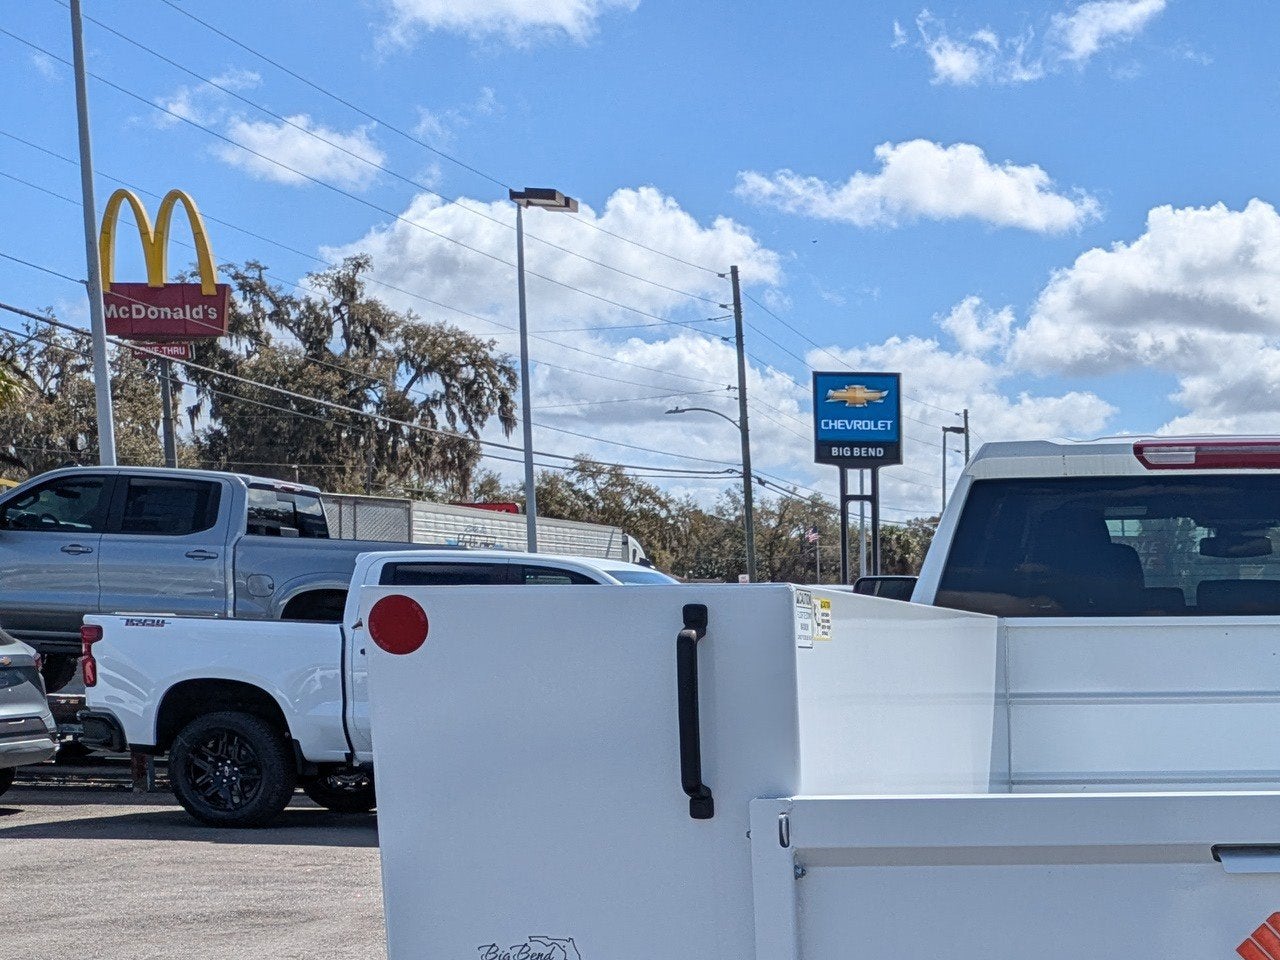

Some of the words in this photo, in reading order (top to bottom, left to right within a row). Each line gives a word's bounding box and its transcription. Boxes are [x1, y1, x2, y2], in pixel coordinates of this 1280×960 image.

[104, 303, 218, 319] McDonald's
[134, 346, 186, 355] IVE-THRU
[821, 419, 894, 430] CHEVROLET
[831, 446, 851, 457] BIG
[853, 446, 884, 457] BEND
